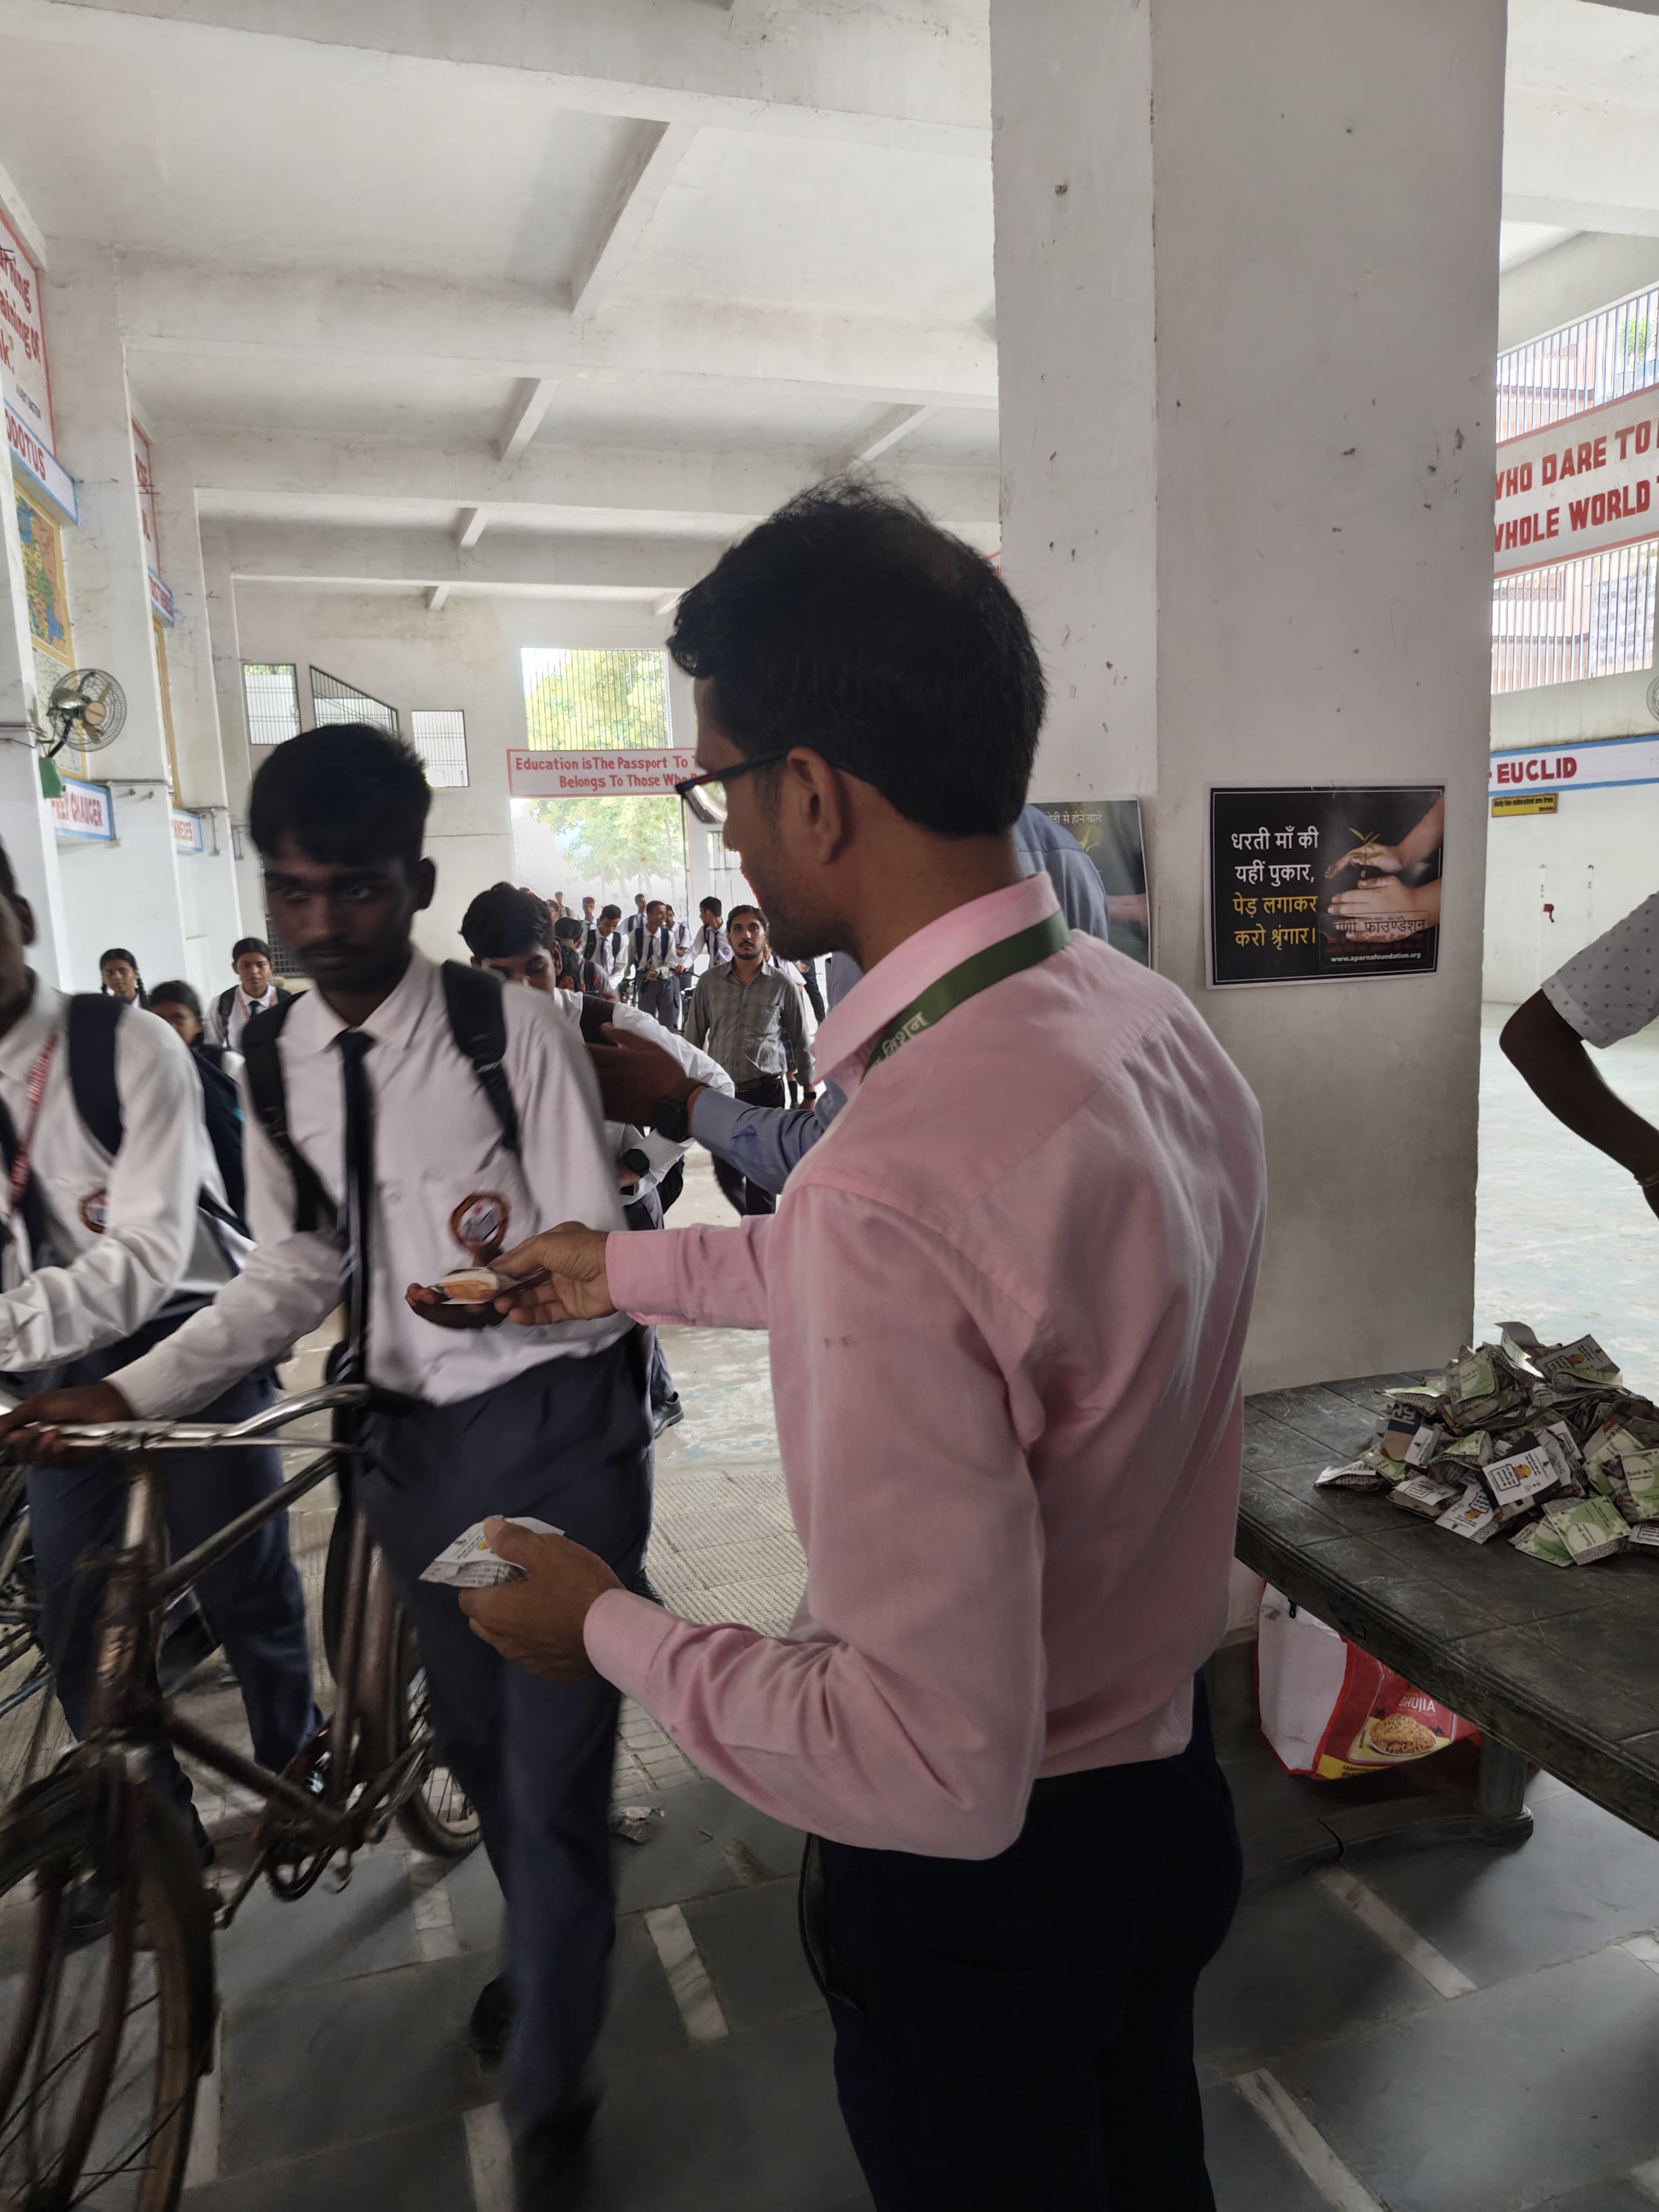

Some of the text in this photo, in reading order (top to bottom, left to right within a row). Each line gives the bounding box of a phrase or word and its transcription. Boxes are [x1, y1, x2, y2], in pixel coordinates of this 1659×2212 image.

[1542, 435, 1607, 486] DARE
[1615, 420, 1651, 461] TO
[1568, 480, 1650, 532] WORLD
[516, 757, 579, 771] Education
[617, 756, 667, 773] Passport
[673, 755, 688, 768] To
[1496, 756, 1577, 784] EUCLID
[559, 774, 606, 792] Belongs
[609, 774, 624, 787] To
[626, 774, 660, 787] Those
[1231, 825, 1319, 851] धरती माँ की
[1235, 859, 1314, 887] यहीं पुकार,
[1232, 892, 1319, 918] पेड़ लगाकर
[1233, 923, 1266, 947] करो
[1331, 952, 1421, 963] www.aparnafoundation.org
